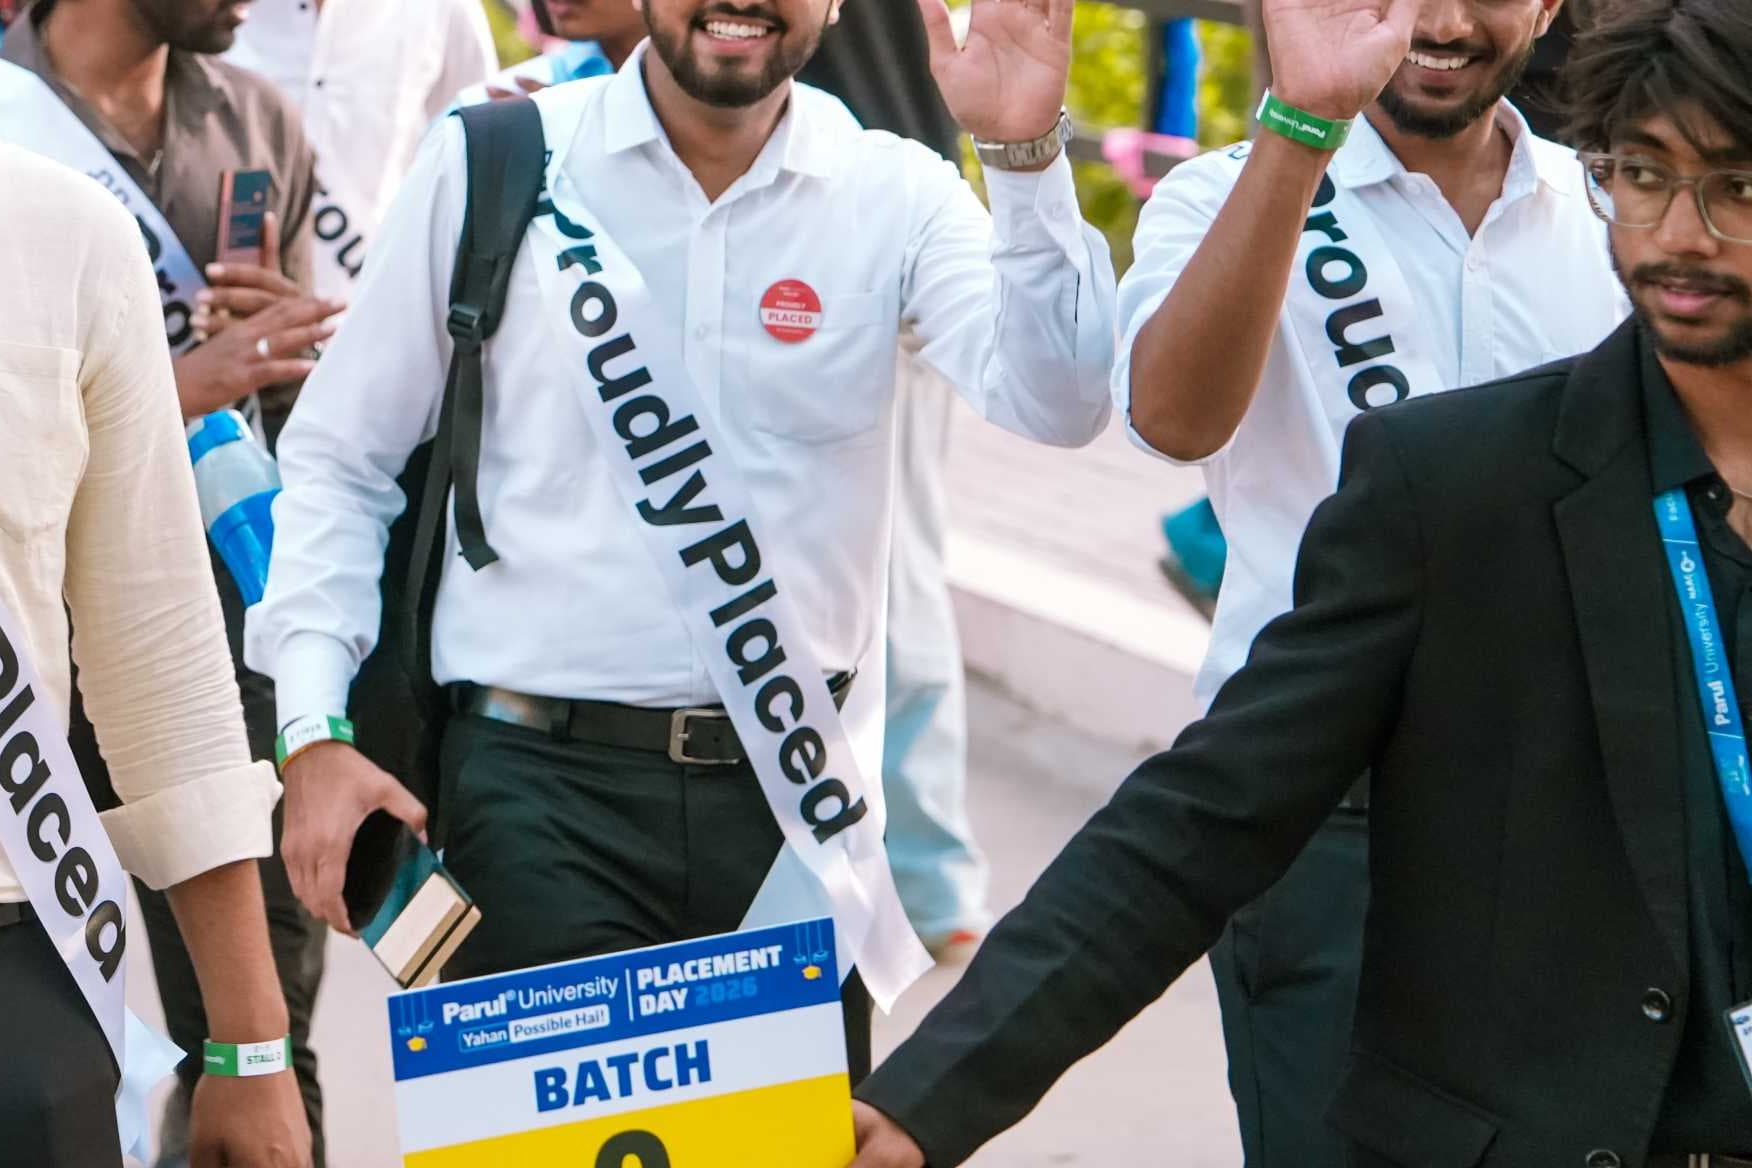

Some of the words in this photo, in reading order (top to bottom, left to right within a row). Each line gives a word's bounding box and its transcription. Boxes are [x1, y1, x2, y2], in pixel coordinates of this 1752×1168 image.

[768, 312, 813, 325] PLACED
[1695, 602, 1720, 675] University
[636, 944, 783, 991] PLACEMENT
[517, 976, 619, 1010] University
[639, 988, 688, 1017] DAY
[695, 976, 758, 1007] 2026
[462, 1028, 508, 1048] Yahan
[514, 1016, 572, 1038] Possible
[575, 1009, 606, 1026] Hai!
[534, 1039, 712, 1113] BATCH
